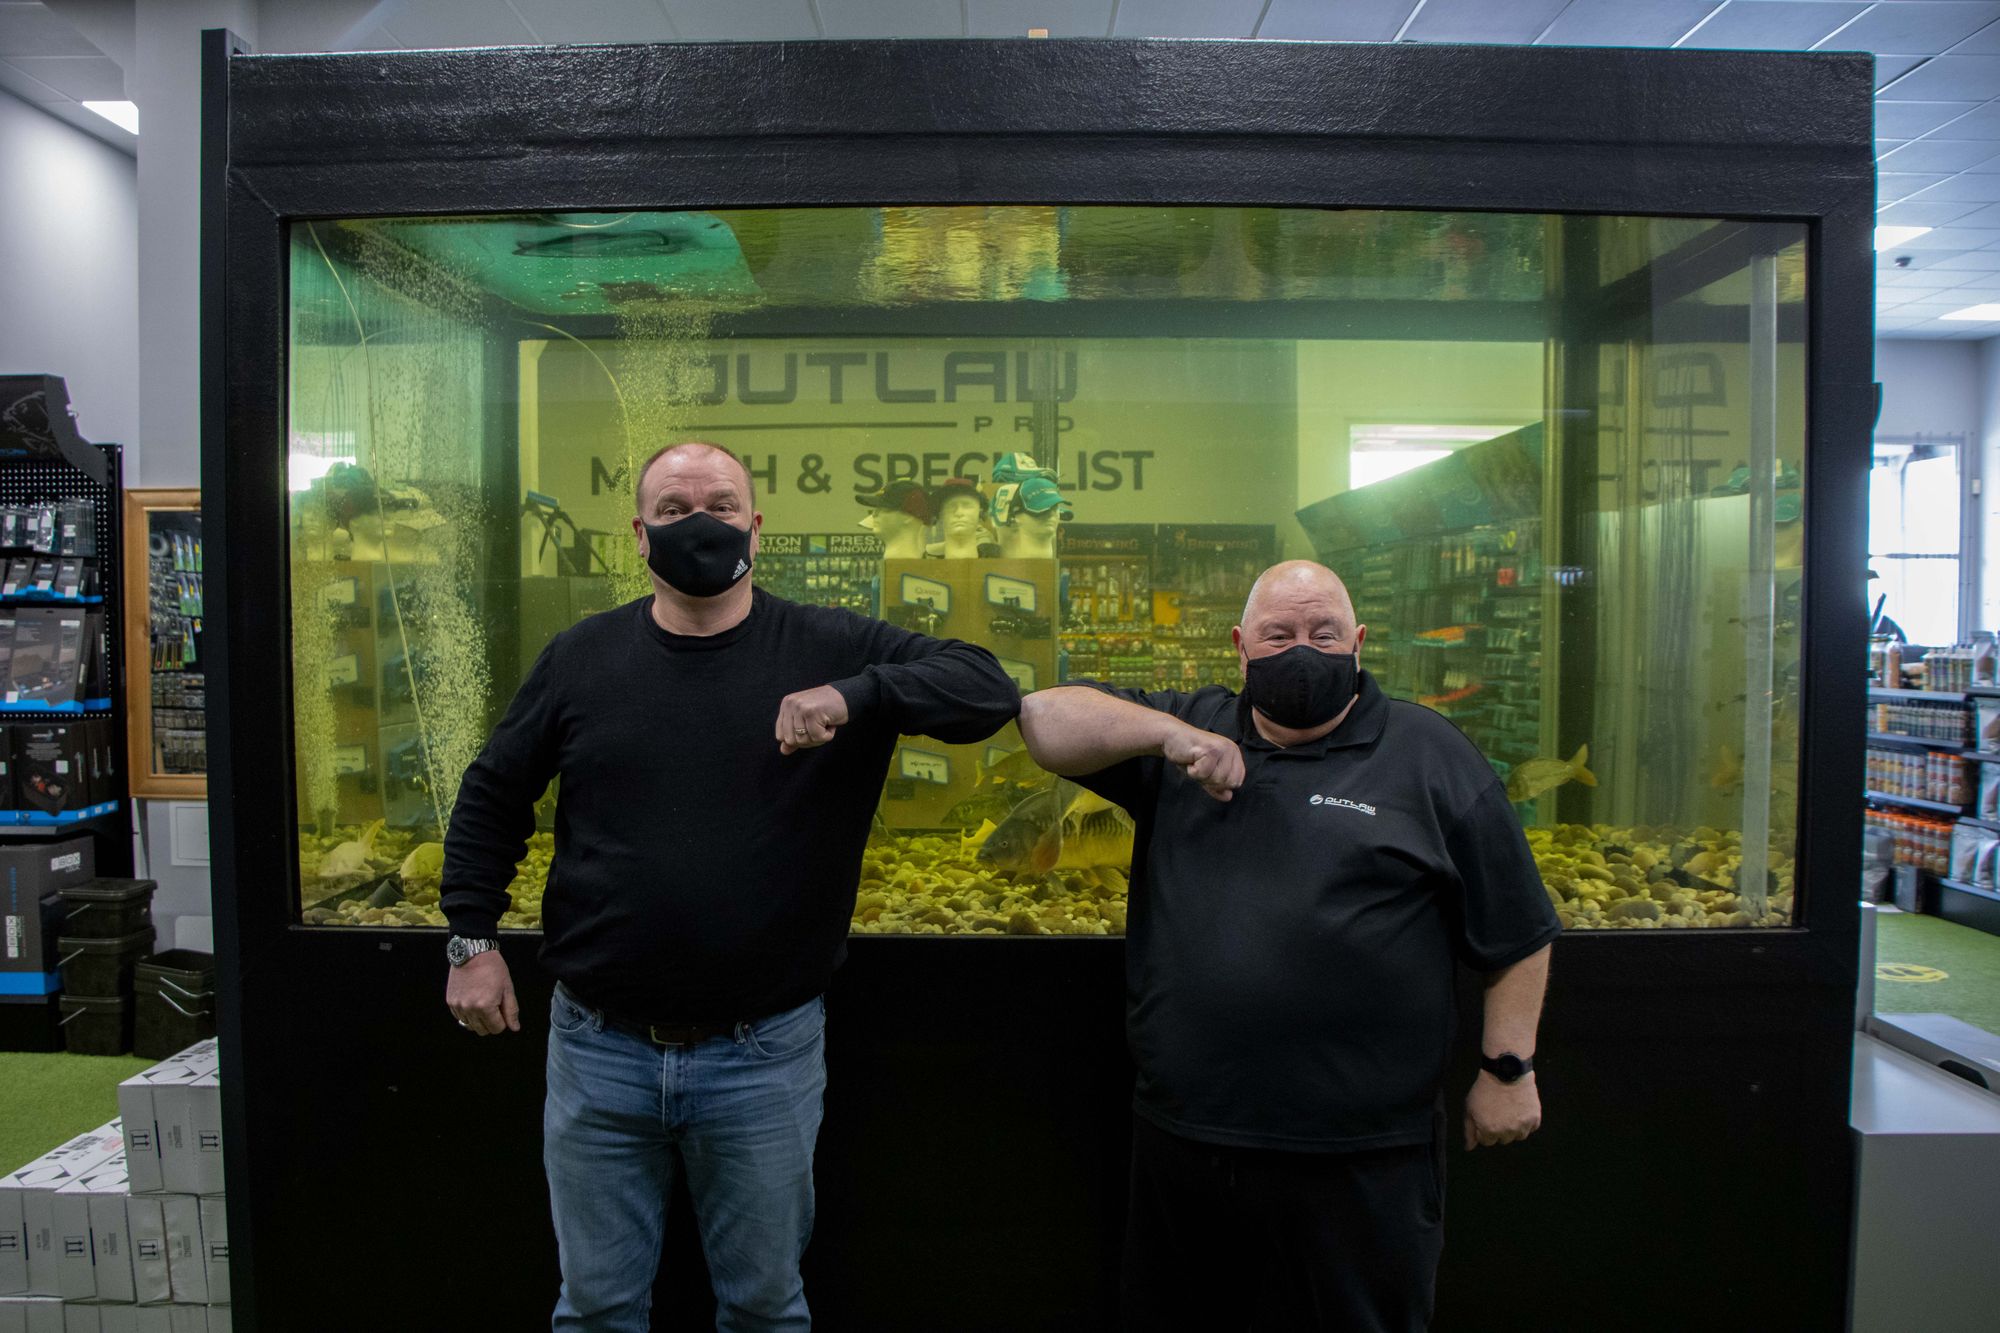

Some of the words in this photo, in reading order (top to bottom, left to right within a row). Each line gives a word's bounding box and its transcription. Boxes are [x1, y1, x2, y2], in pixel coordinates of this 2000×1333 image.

[666, 352, 1078, 406] OUTLAW
[974, 416, 1075, 433] PRO
[797, 453, 832, 494] &
[852, 450, 1154, 494] SPECIST
[759, 535, 802, 546] STON
[831, 535, 879, 546] PRES
[758, 545, 801, 554] ATIONS
[1324, 796, 1376, 813] OUTLAW
